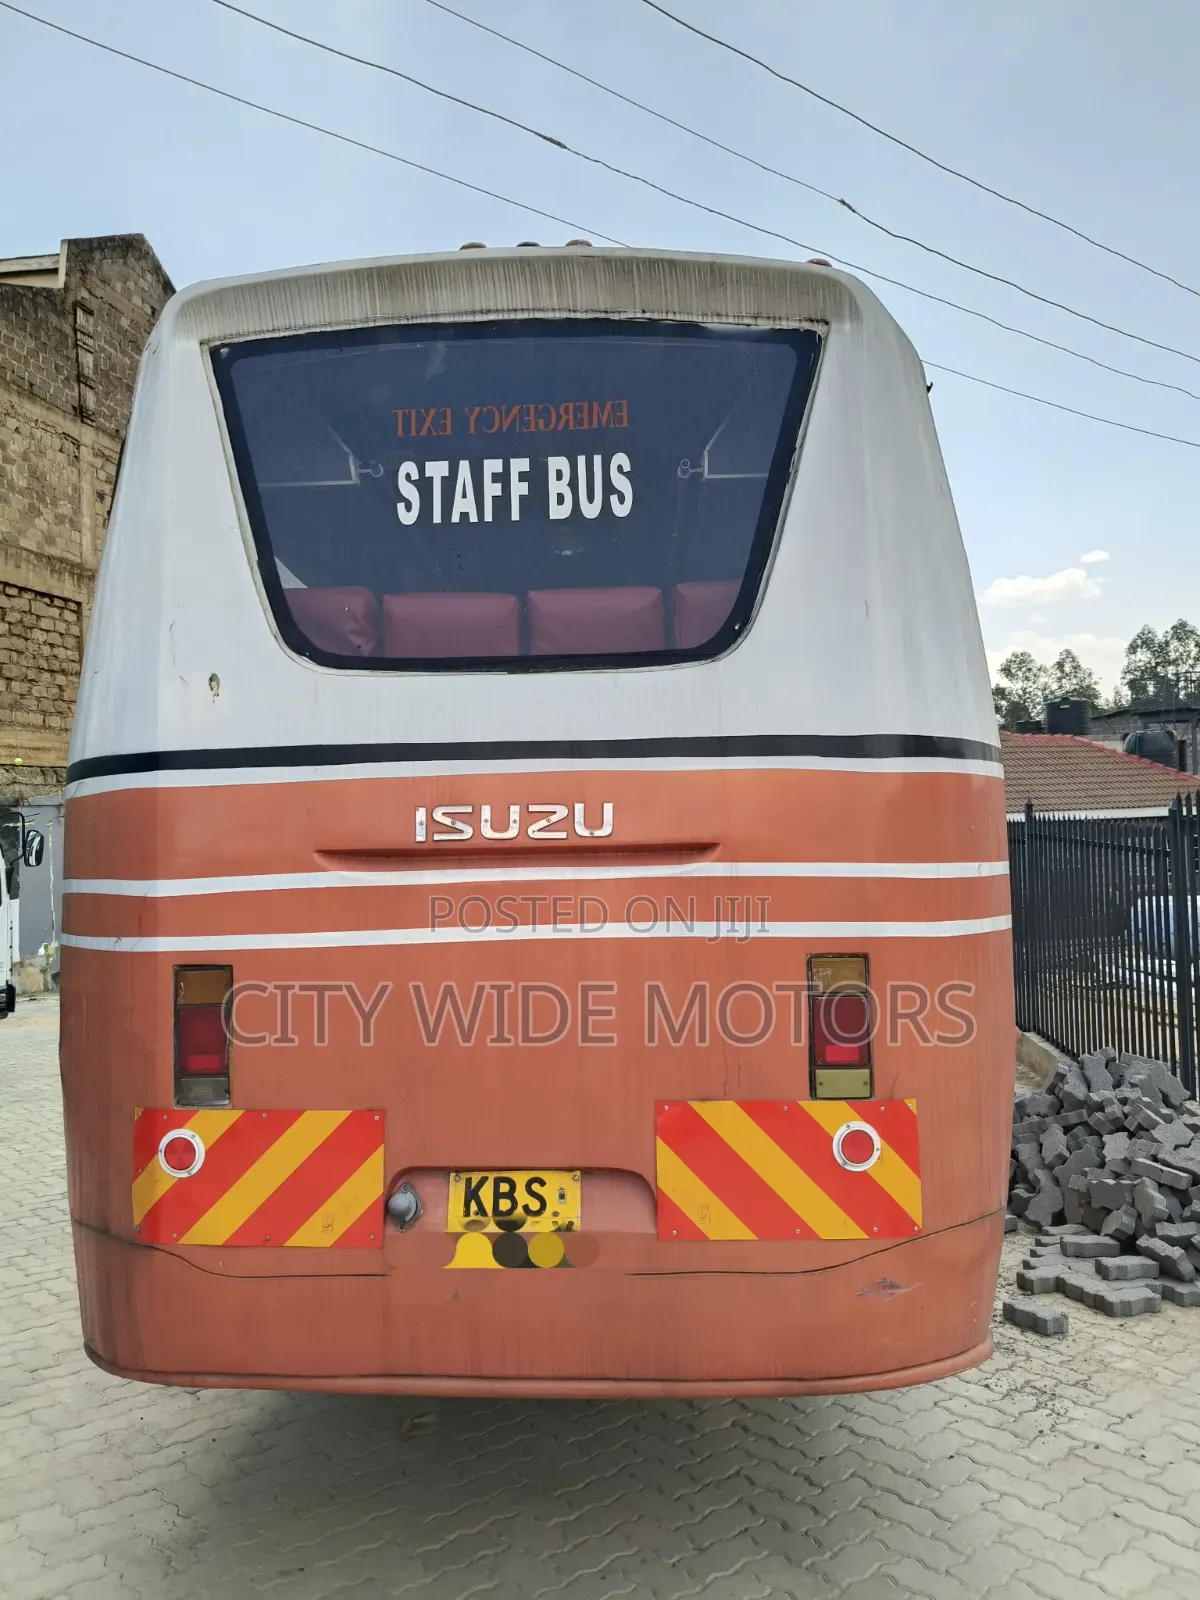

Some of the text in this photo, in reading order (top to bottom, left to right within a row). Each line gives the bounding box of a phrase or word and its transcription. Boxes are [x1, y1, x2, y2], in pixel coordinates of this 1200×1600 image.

[396, 452, 634, 526] STAFF BUS
[414, 802, 614, 843] ISUZU
[463, 1176, 547, 1217] KBS
